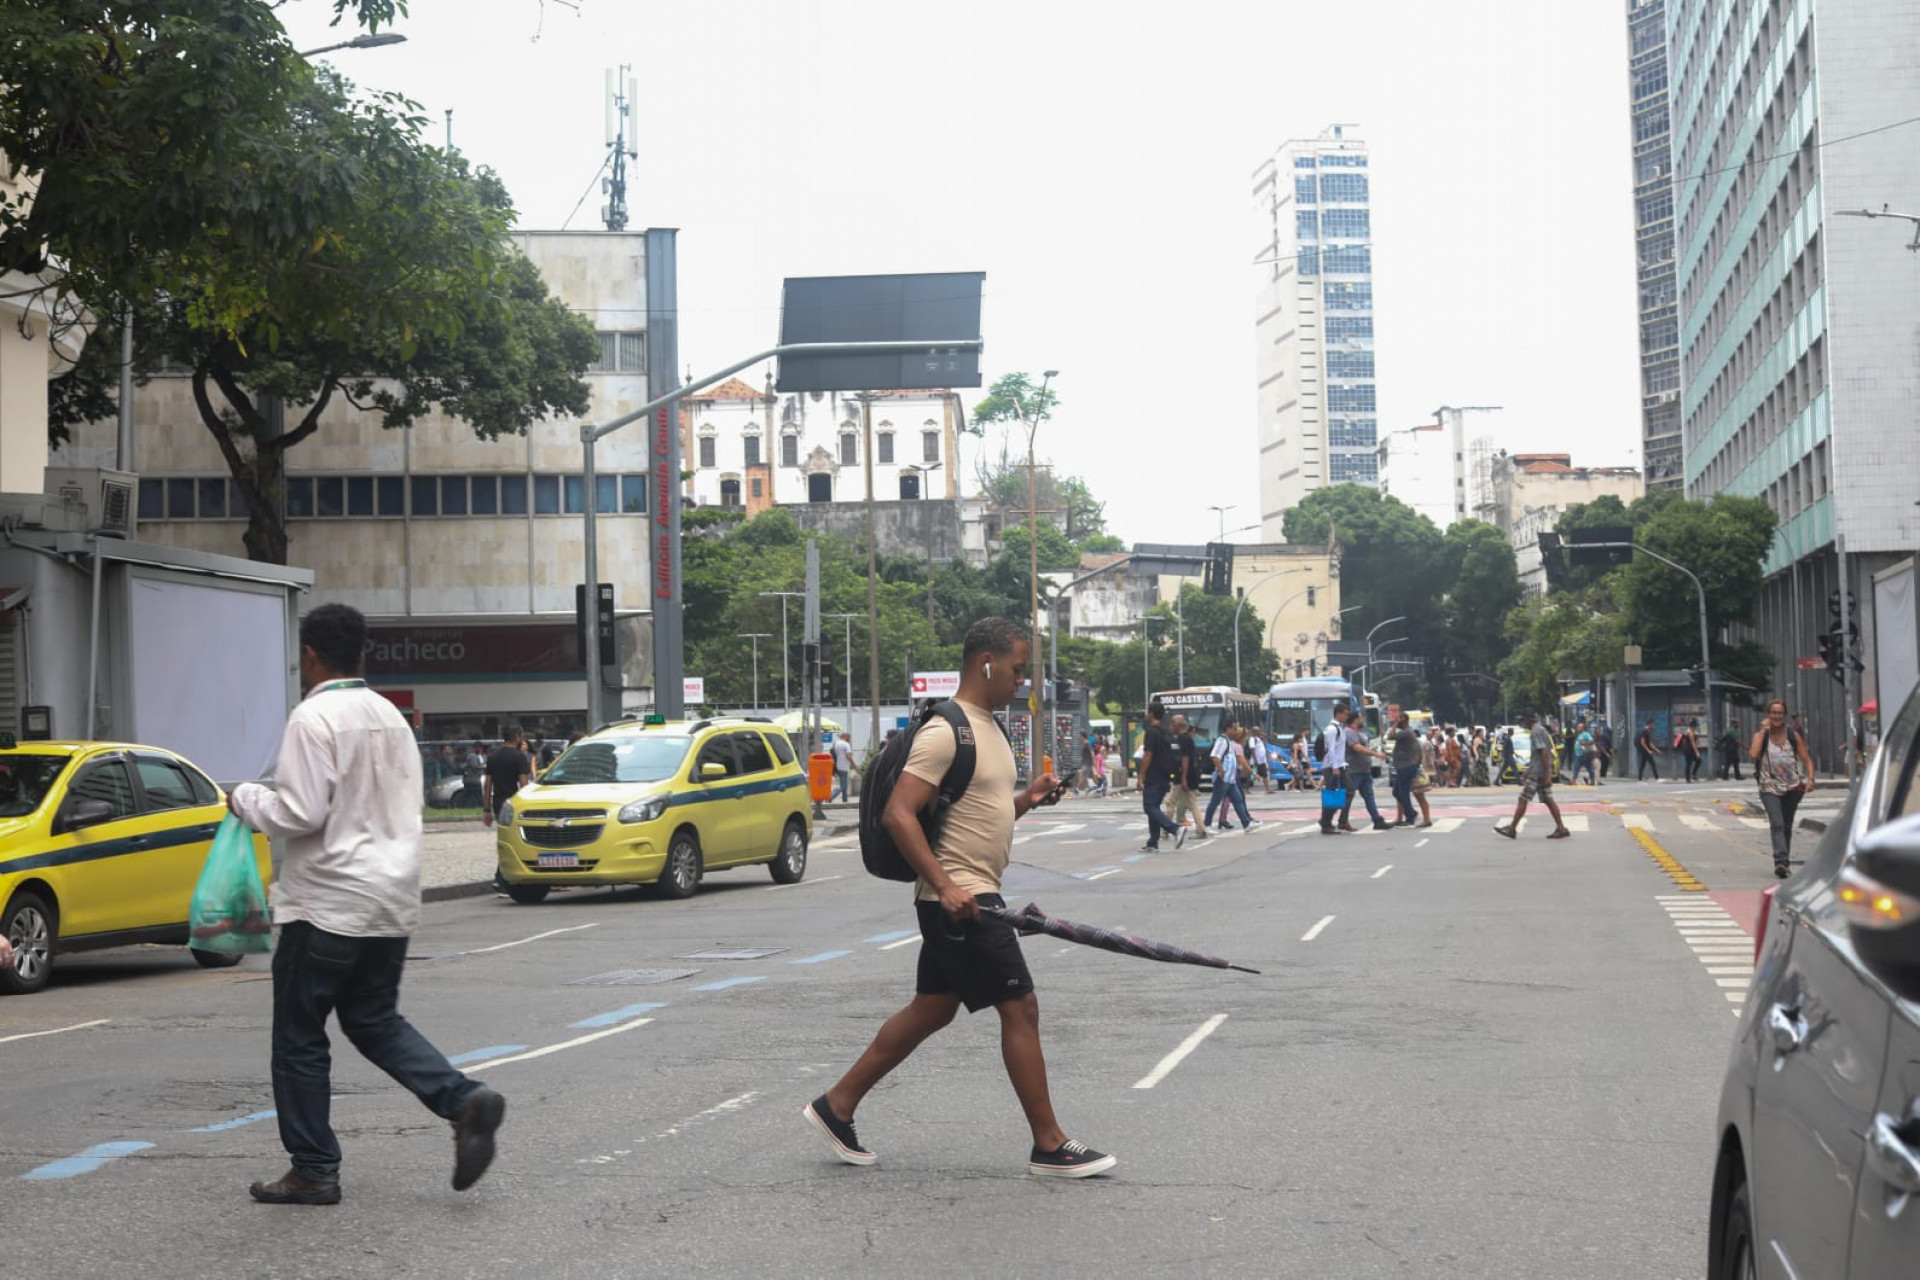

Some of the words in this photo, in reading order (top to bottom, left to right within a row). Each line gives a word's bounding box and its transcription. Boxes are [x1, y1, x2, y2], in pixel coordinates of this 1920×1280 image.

[656, 461, 670, 527] Avenida
[360, 636, 465, 661] Pacheco
[1176, 694, 1213, 704] CASTELO
